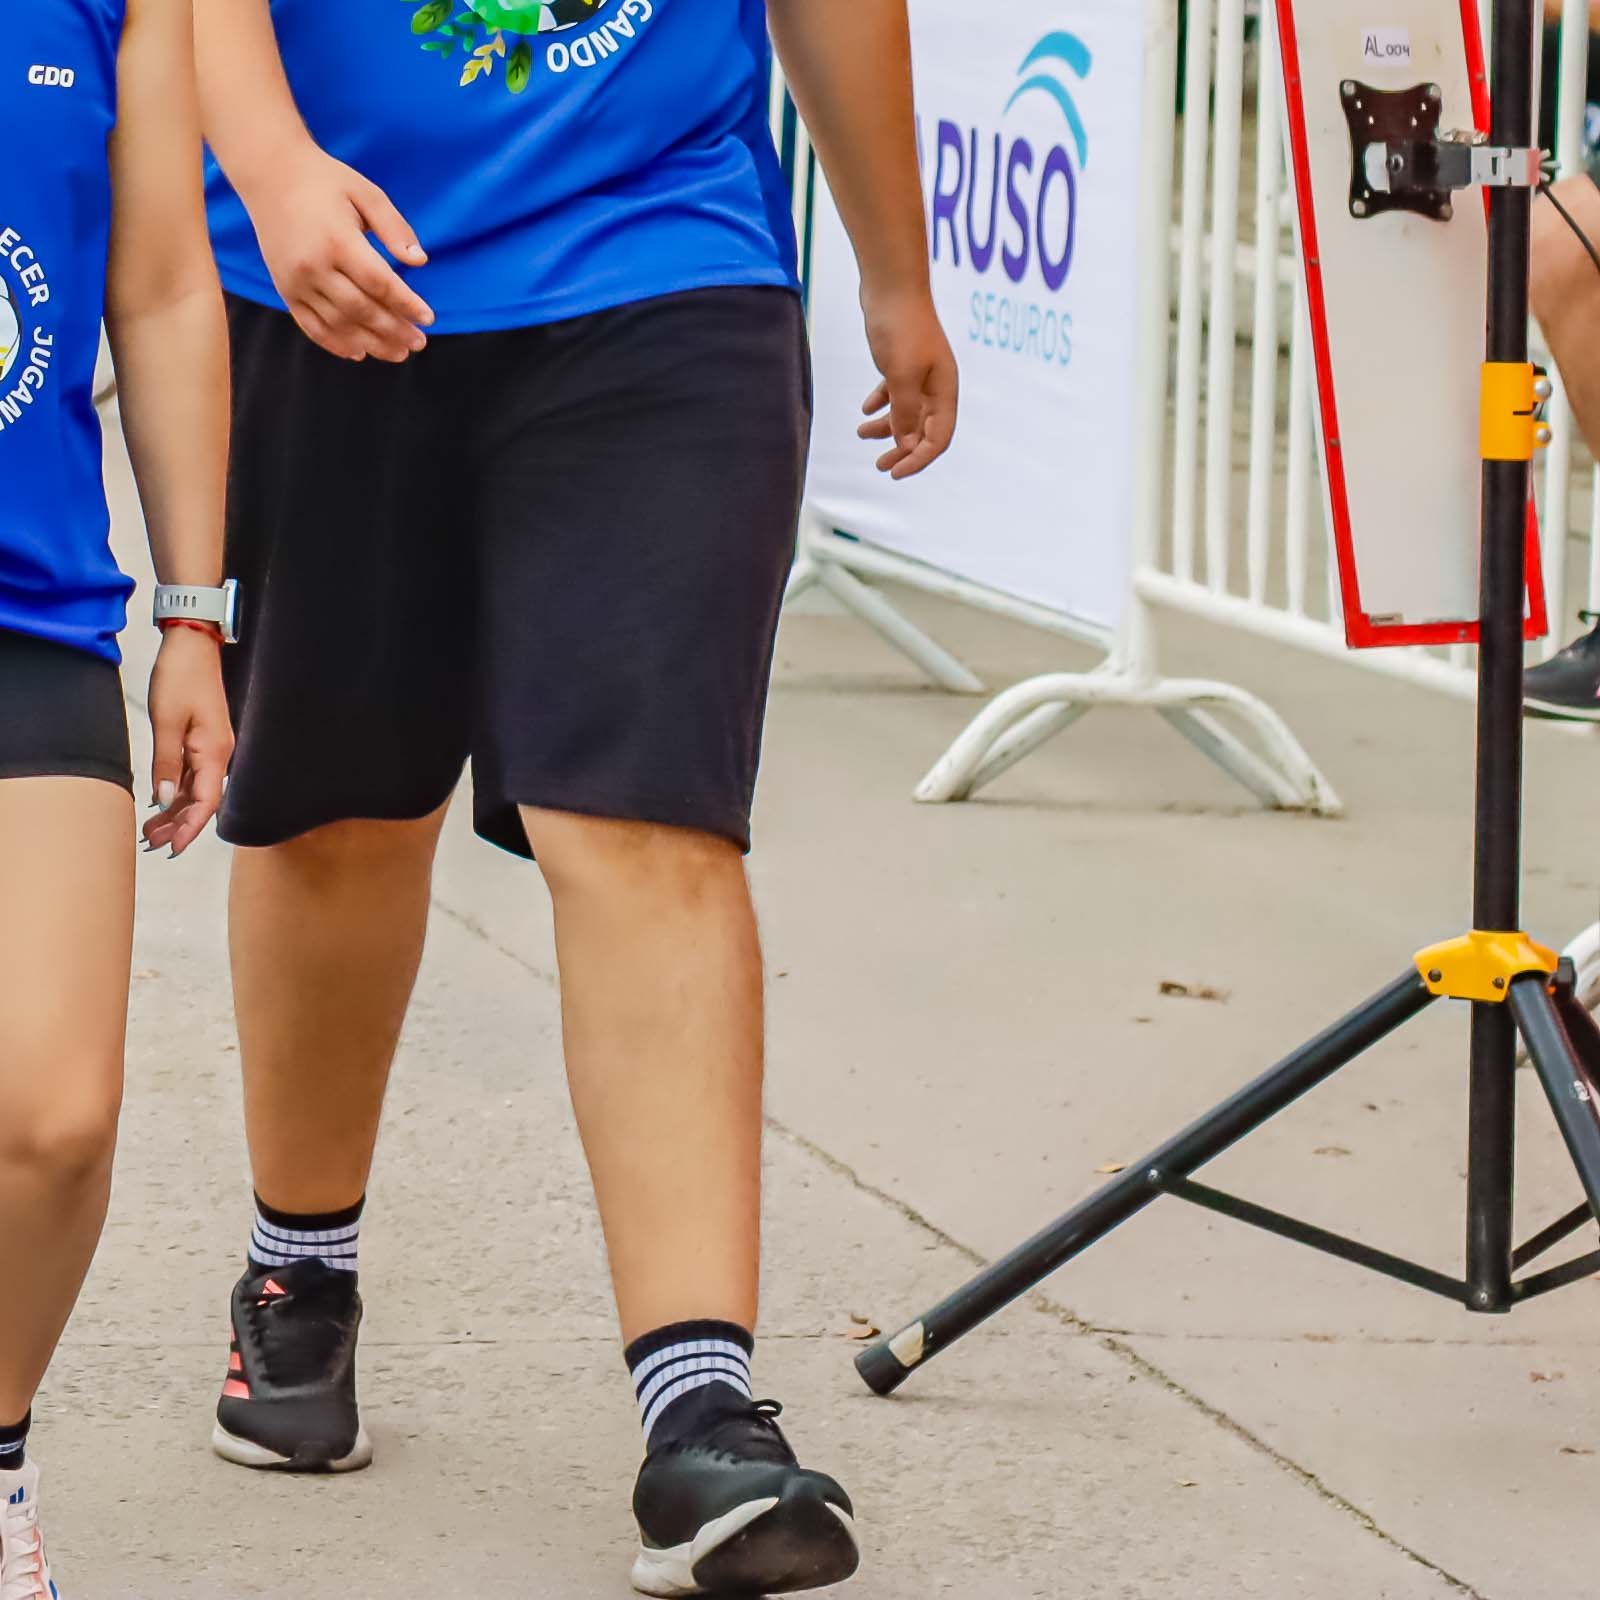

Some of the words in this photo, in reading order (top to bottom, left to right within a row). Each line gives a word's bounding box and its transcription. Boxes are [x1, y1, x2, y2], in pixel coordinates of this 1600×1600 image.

[28, 65, 75, 89] GDO
[917, 116, 1077, 292] RUSO
[968, 290, 1074, 367] SEGUROS
